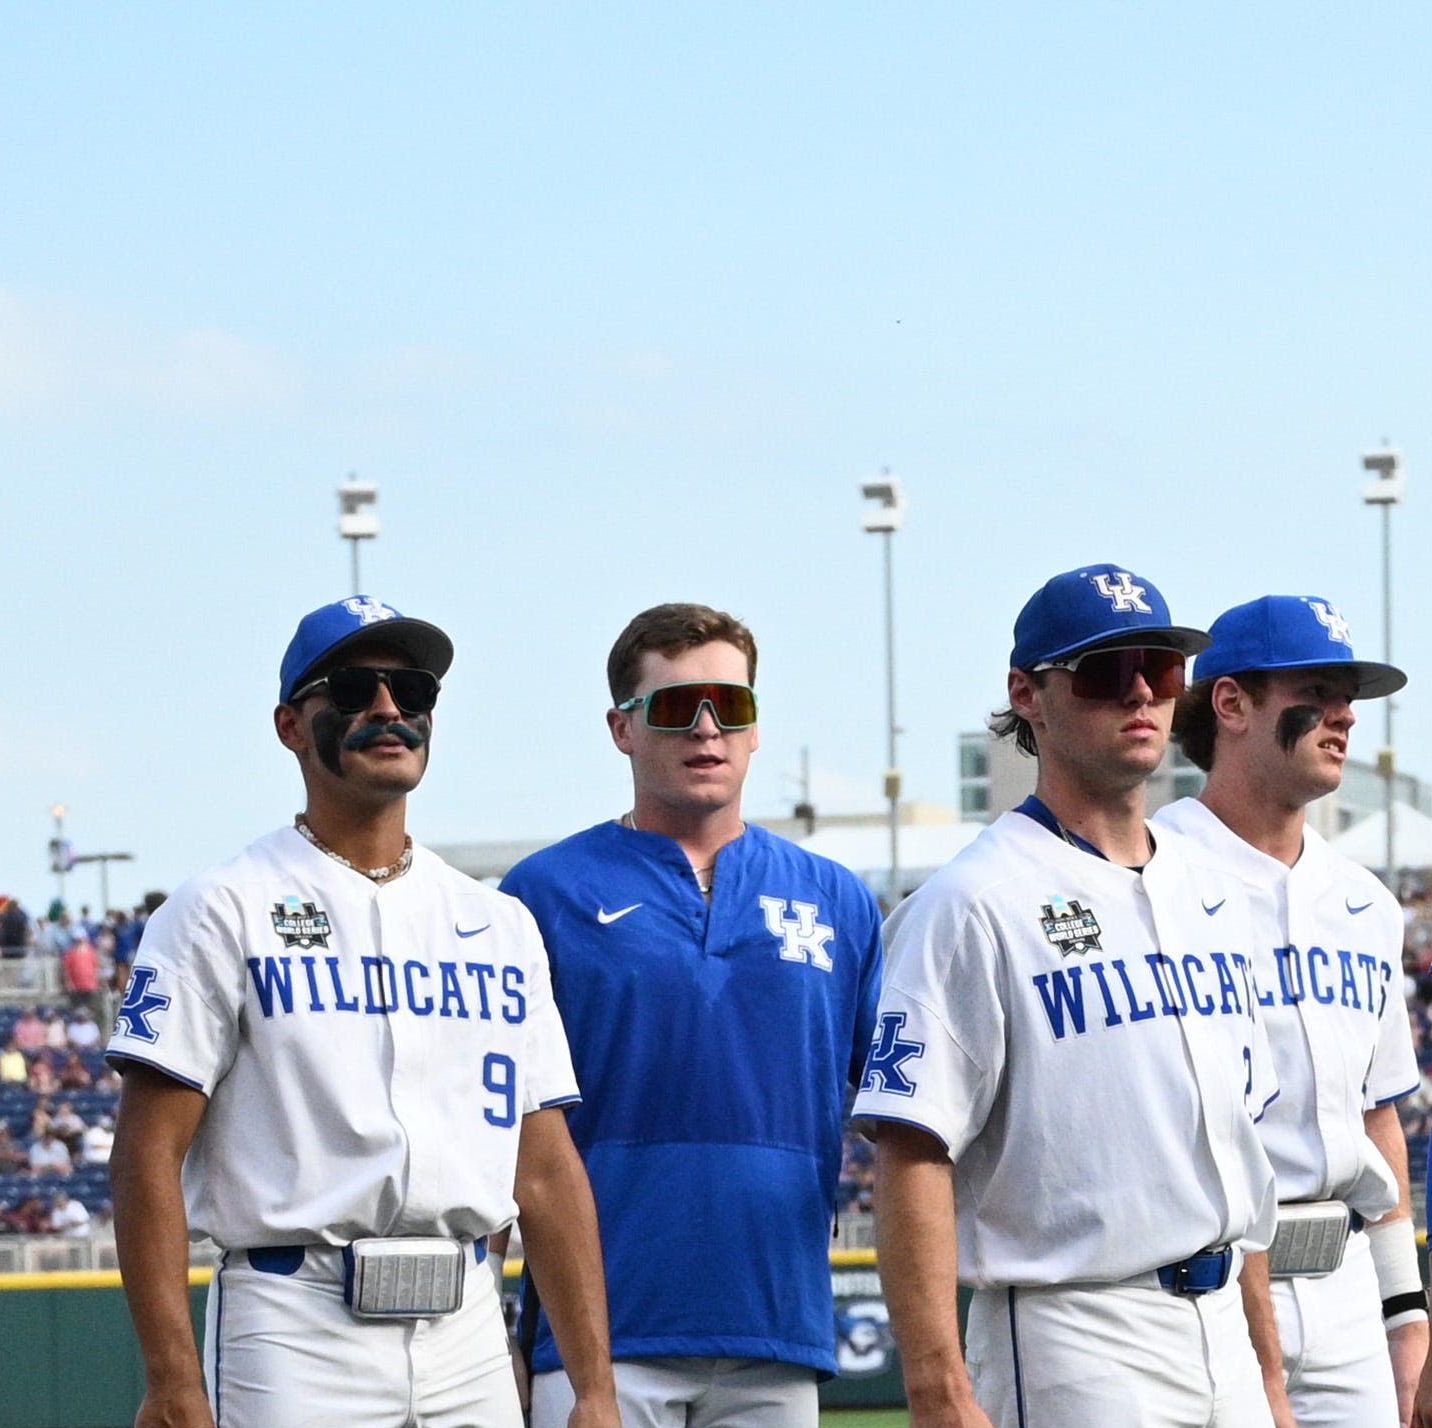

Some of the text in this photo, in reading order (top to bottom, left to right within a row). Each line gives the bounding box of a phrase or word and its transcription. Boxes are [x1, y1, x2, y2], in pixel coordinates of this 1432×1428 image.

[1088, 571, 1153, 614] UK
[759, 895, 835, 973] UK
[1054, 919, 1085, 932] COLLEGE
[247, 955, 527, 1024] WILDCATS
[482, 1052, 517, 1129] 9
